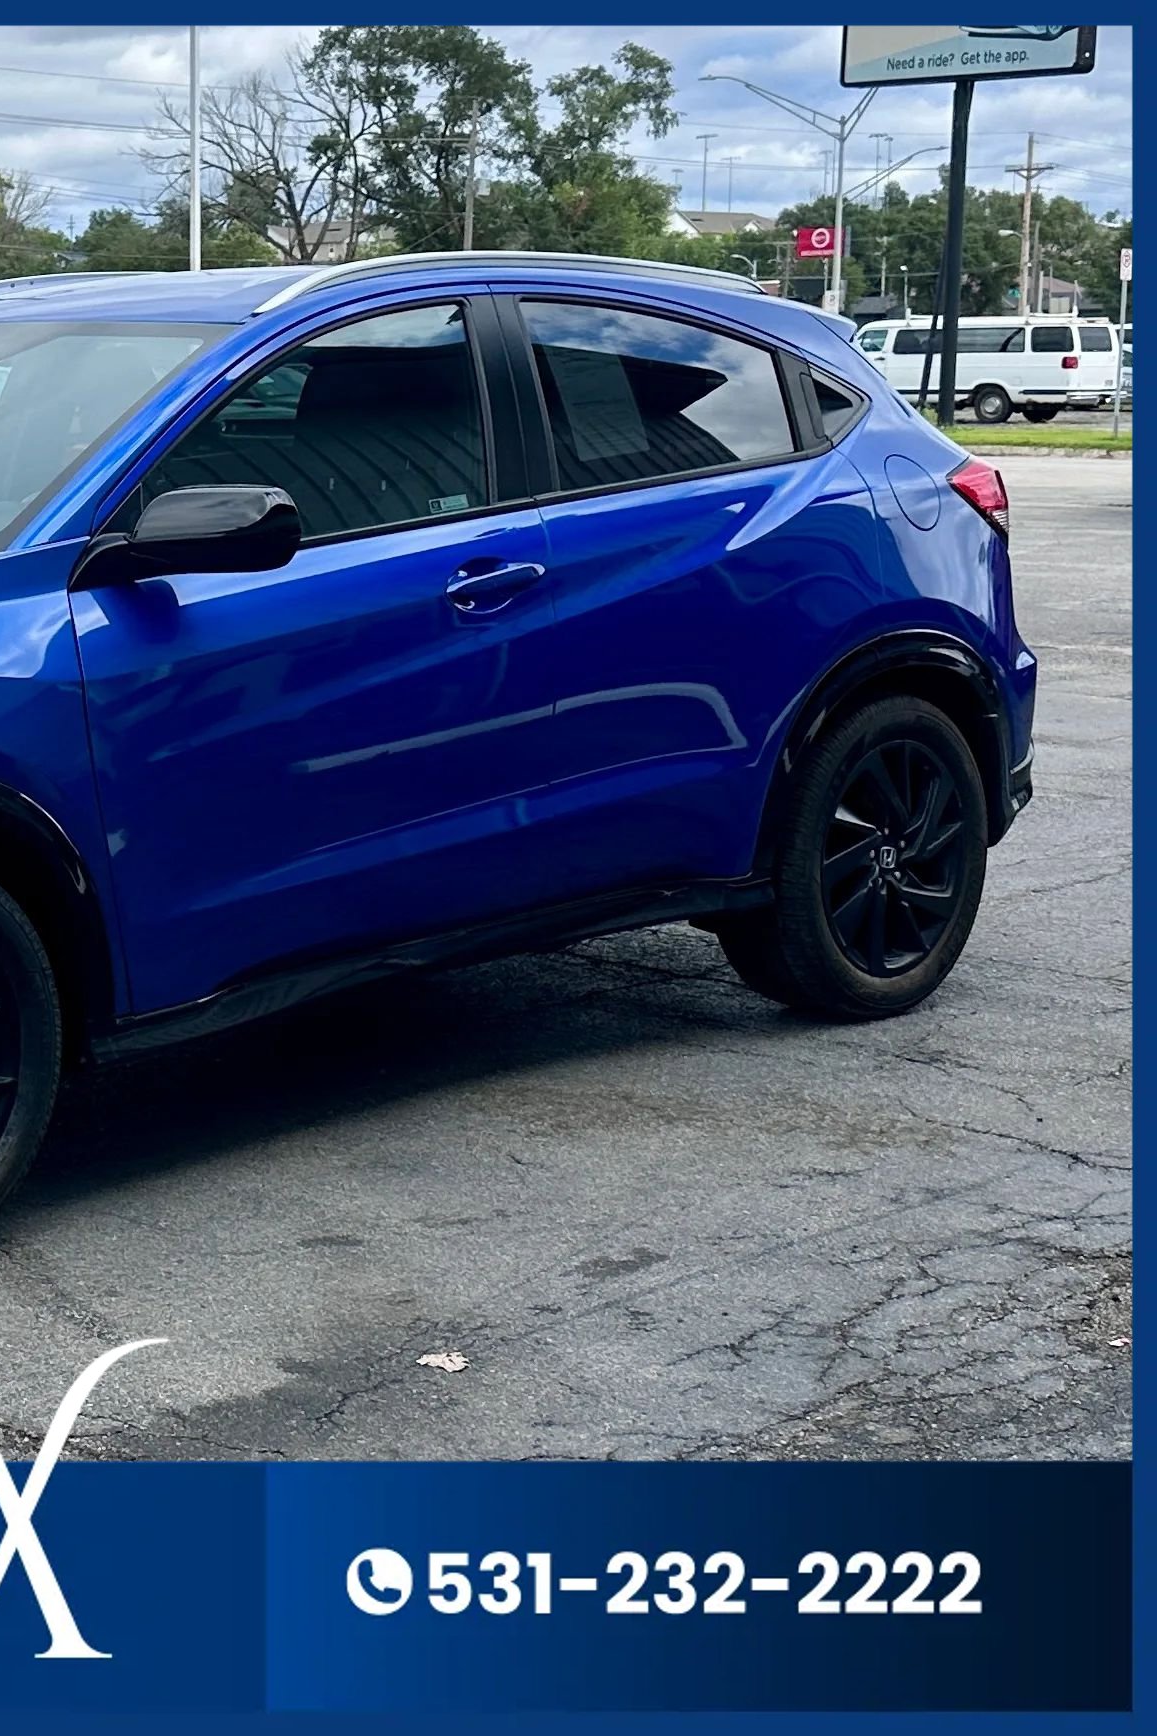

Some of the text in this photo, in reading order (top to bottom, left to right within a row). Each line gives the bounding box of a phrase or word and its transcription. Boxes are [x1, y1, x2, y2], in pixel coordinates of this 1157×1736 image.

[886, 50, 1030, 70] Need a ride? Get the app.
